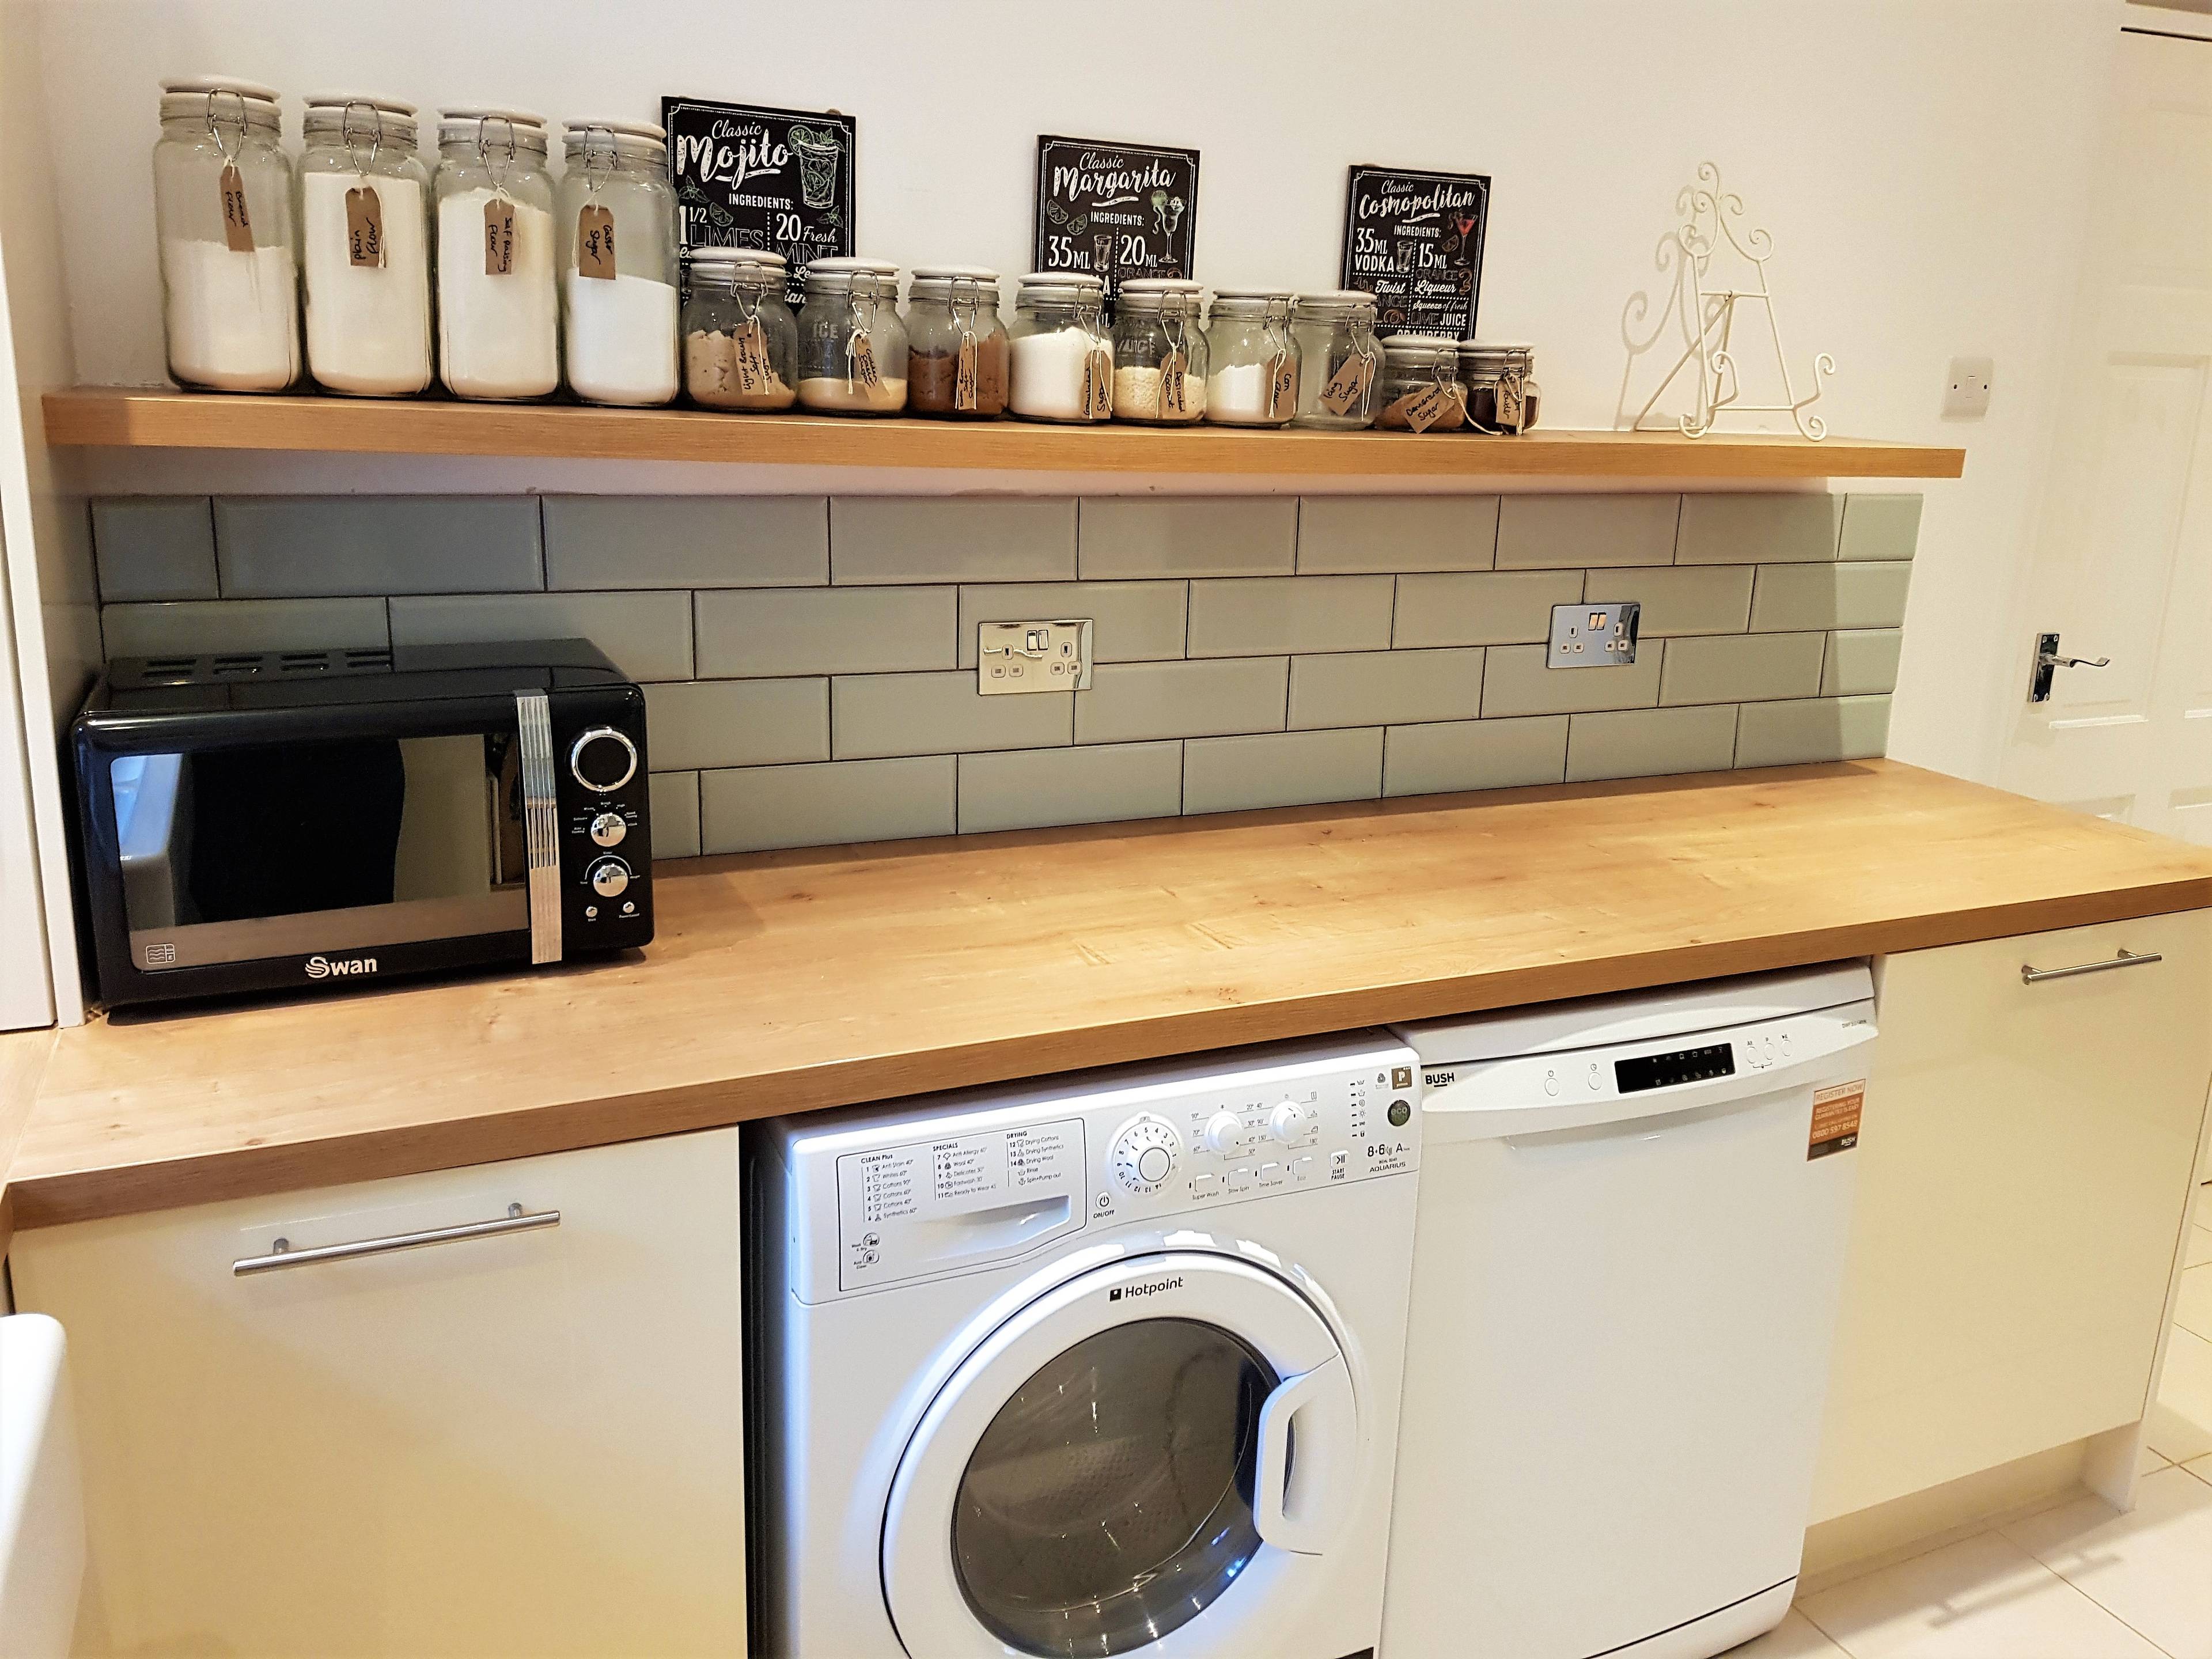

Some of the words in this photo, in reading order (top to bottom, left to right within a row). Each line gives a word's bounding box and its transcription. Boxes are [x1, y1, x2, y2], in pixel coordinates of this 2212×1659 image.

[712, 120, 762, 139] Classic
[677, 129, 793, 190] Mojito
[1080, 151, 1124, 171] Classic
[1054, 158, 1176, 202] Margarita
[1381, 180, 1414, 195] Classic
[729, 193, 794, 210] INGREDIENTS:
[1359, 184, 1475, 219] Cosmopolitan
[1090, 211, 1145, 226] INGREDIENTS:
[776, 213, 801, 241] 20
[802, 226, 838, 243] Fresh
[1394, 225, 1441, 238] INGREDIENTS:
[691, 225, 764, 249] LIMES
[1355, 255, 1395, 272] VODKA
[1375, 280, 1406, 294] Twist
[1414, 280, 1456, 296] Liqueur
[1412, 300, 1442, 312] Squeeze
[1442, 300, 1450, 311] of
[1449, 300, 1468, 312] fresh
[1411, 313, 1440, 325] LIME
[1440, 313, 1467, 327] JUICE
[305, 956, 377, 979] Swan
[1425, 1072, 1455, 1085] BUSH
[1816, 1088, 1844, 1101] REGISTER
[1847, 1084, 1863, 1093] NOW
[1006, 1131, 1027, 1139] DRYING
[933, 1143, 958, 1152] SPECIALS
[861, 1156, 880, 1164] CLEAN
[1369, 1161, 1406, 1173] AQUARIUS
[1093, 1210, 1115, 1218] ON/OFF
[1125, 1277, 1183, 1298] Hotpoint
